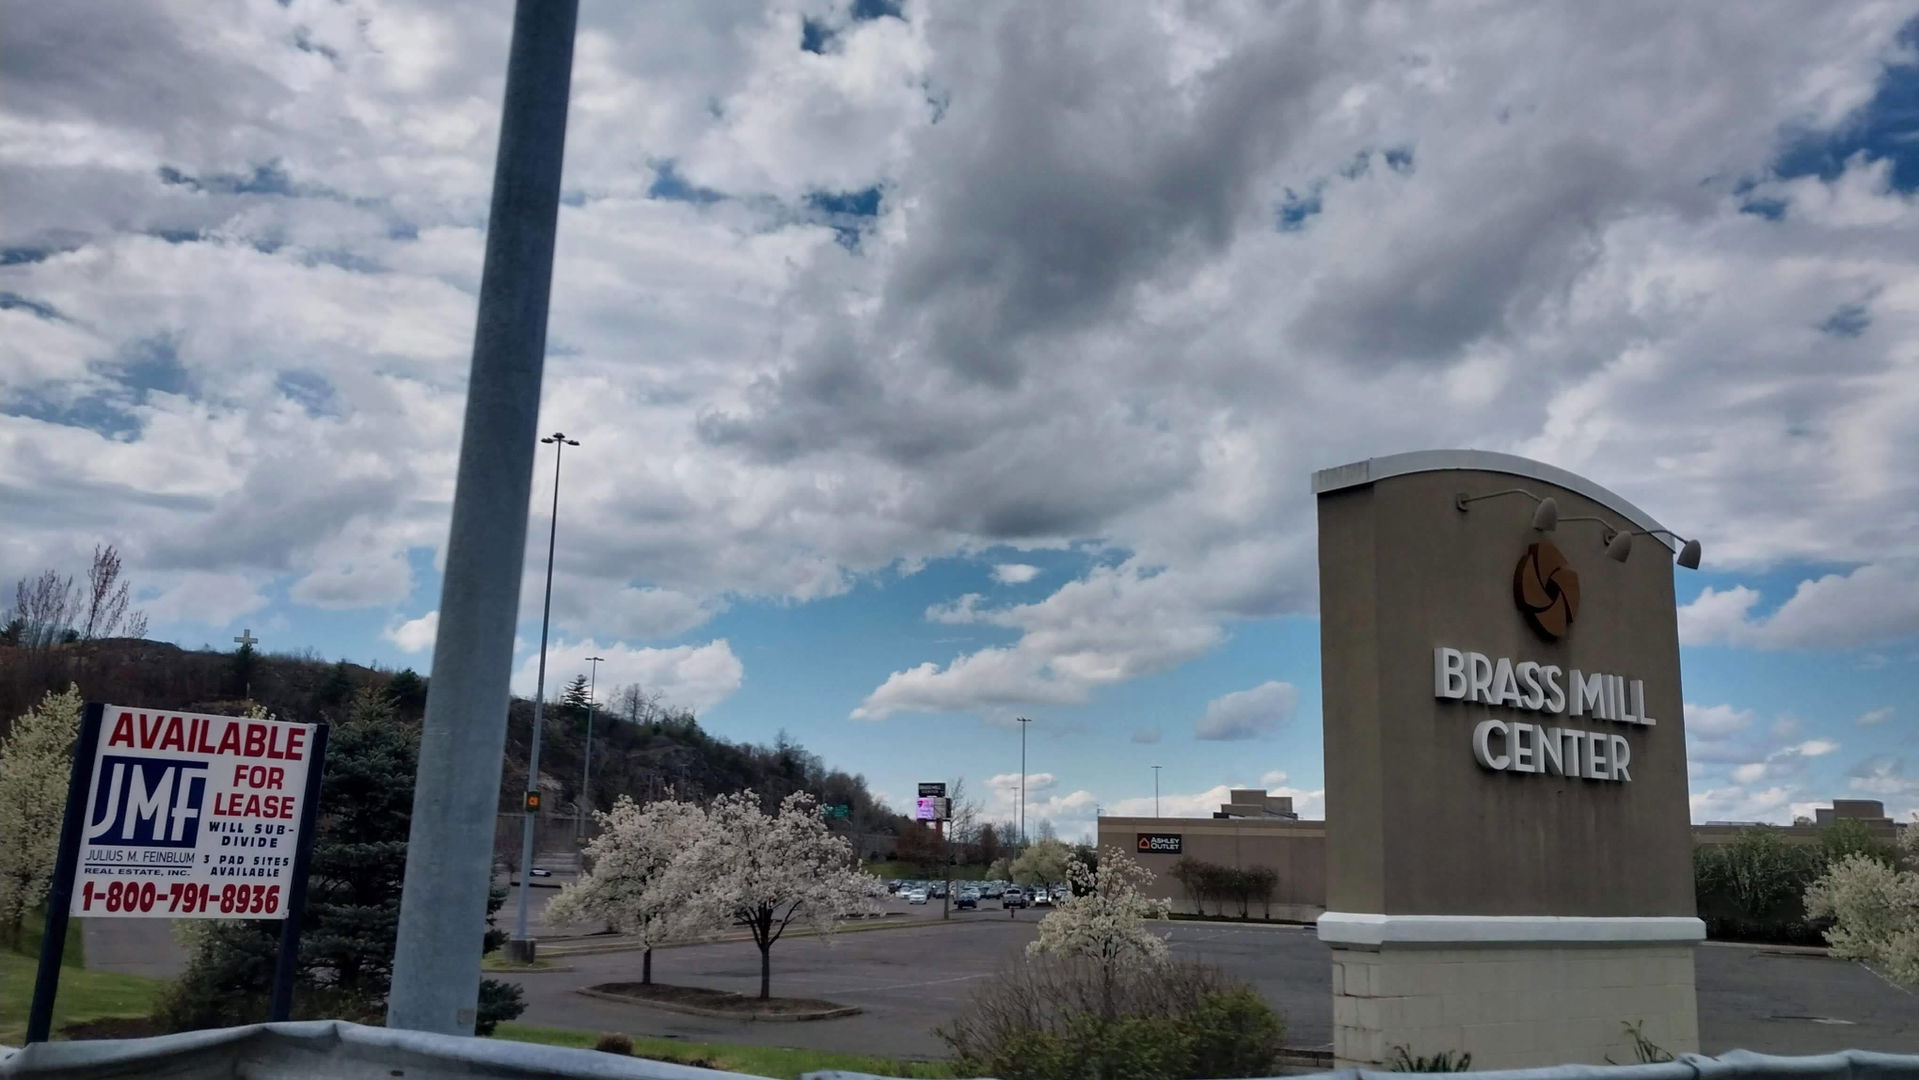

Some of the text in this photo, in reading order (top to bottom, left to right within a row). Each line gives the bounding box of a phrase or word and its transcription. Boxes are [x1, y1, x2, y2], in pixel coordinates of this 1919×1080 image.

[1434, 647, 1656, 726] BRASS MILL
[108, 712, 306, 761] AVAILABLE
[1473, 719, 1632, 782] CENTER
[233, 764, 285, 790] FOR
[88, 762, 209, 842] JMF
[213, 792, 295, 819] LEASE
[208, 821, 295, 835] WILL SUB-
[221, 835, 278, 848] DIVIDE
[1150, 836, 1180, 844] ASHLEY
[85, 849, 196, 864] JULIUS M. FEINBLUM
[203, 854, 289, 867] 3 PAD SITES
[84, 867, 191, 877] REAL ESTATE, INC.
[210, 866, 280, 878] AVAILABLE
[82, 880, 280, 914] 1-800-791-8936
